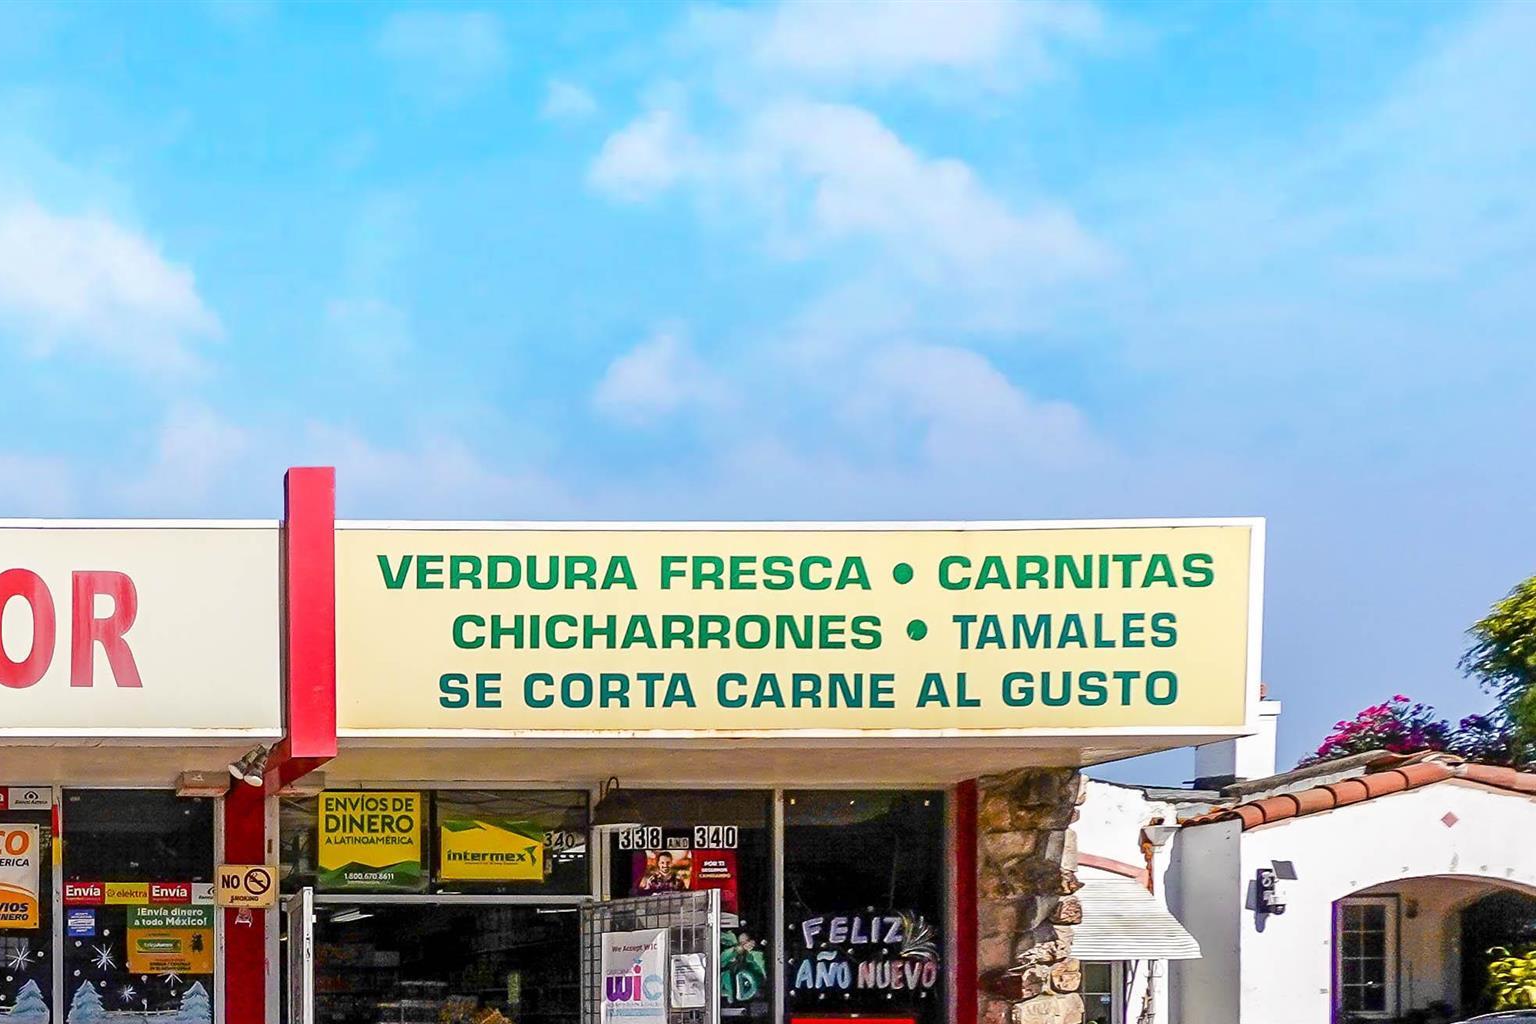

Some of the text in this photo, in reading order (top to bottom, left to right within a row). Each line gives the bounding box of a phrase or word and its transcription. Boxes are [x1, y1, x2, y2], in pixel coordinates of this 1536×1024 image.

[376, 553, 1215, 590] VERDURA FRESCA CARNITAS
[452, 613, 1179, 650] CHICHARRONES TAMALES
[438, 670, 1179, 708] SE CORTA CARNE AL GUSTO
[325, 795, 413, 812] ENVÍOS DE
[325, 815, 414, 833] DINERO
[543, 833, 575, 848] 340
[620, 827, 736, 849] 338 AND 340
[447, 849, 526, 861] intermex
[222, 875, 240, 888] NO
[66, 884, 101, 896] Envía
[116, 889, 147, 898] elektra
[152, 886, 187, 897] Envía
[171, 908, 203, 916] dinero
[142, 917, 163, 926] todo
[166, 917, 207, 926] México!
[802, 917, 903, 949] FELIZ
[795, 951, 937, 989] AÑO NUEVO
